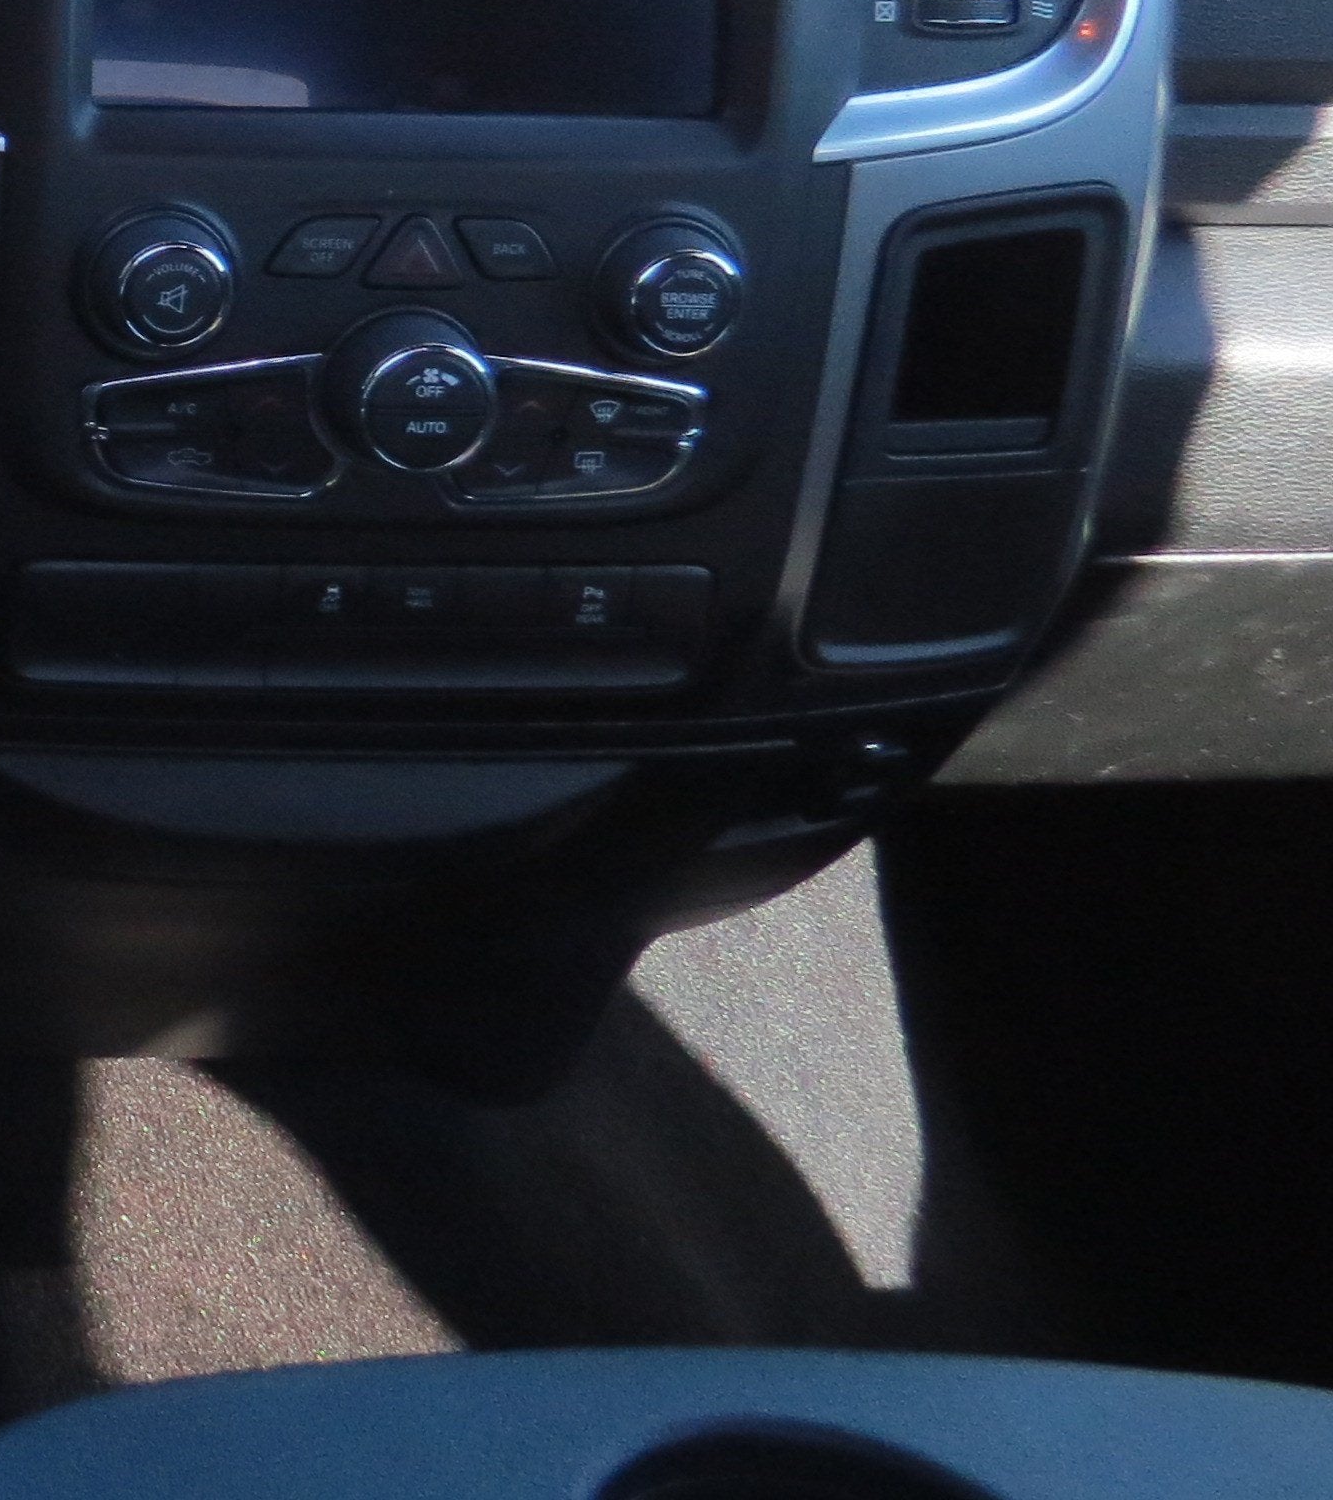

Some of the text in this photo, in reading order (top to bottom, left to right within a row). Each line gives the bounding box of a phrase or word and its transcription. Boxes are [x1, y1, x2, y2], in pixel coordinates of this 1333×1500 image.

[492, 242, 527, 255] BACK
[414, 385, 446, 398] OFF
[404, 420, 448, 434] AUTO
